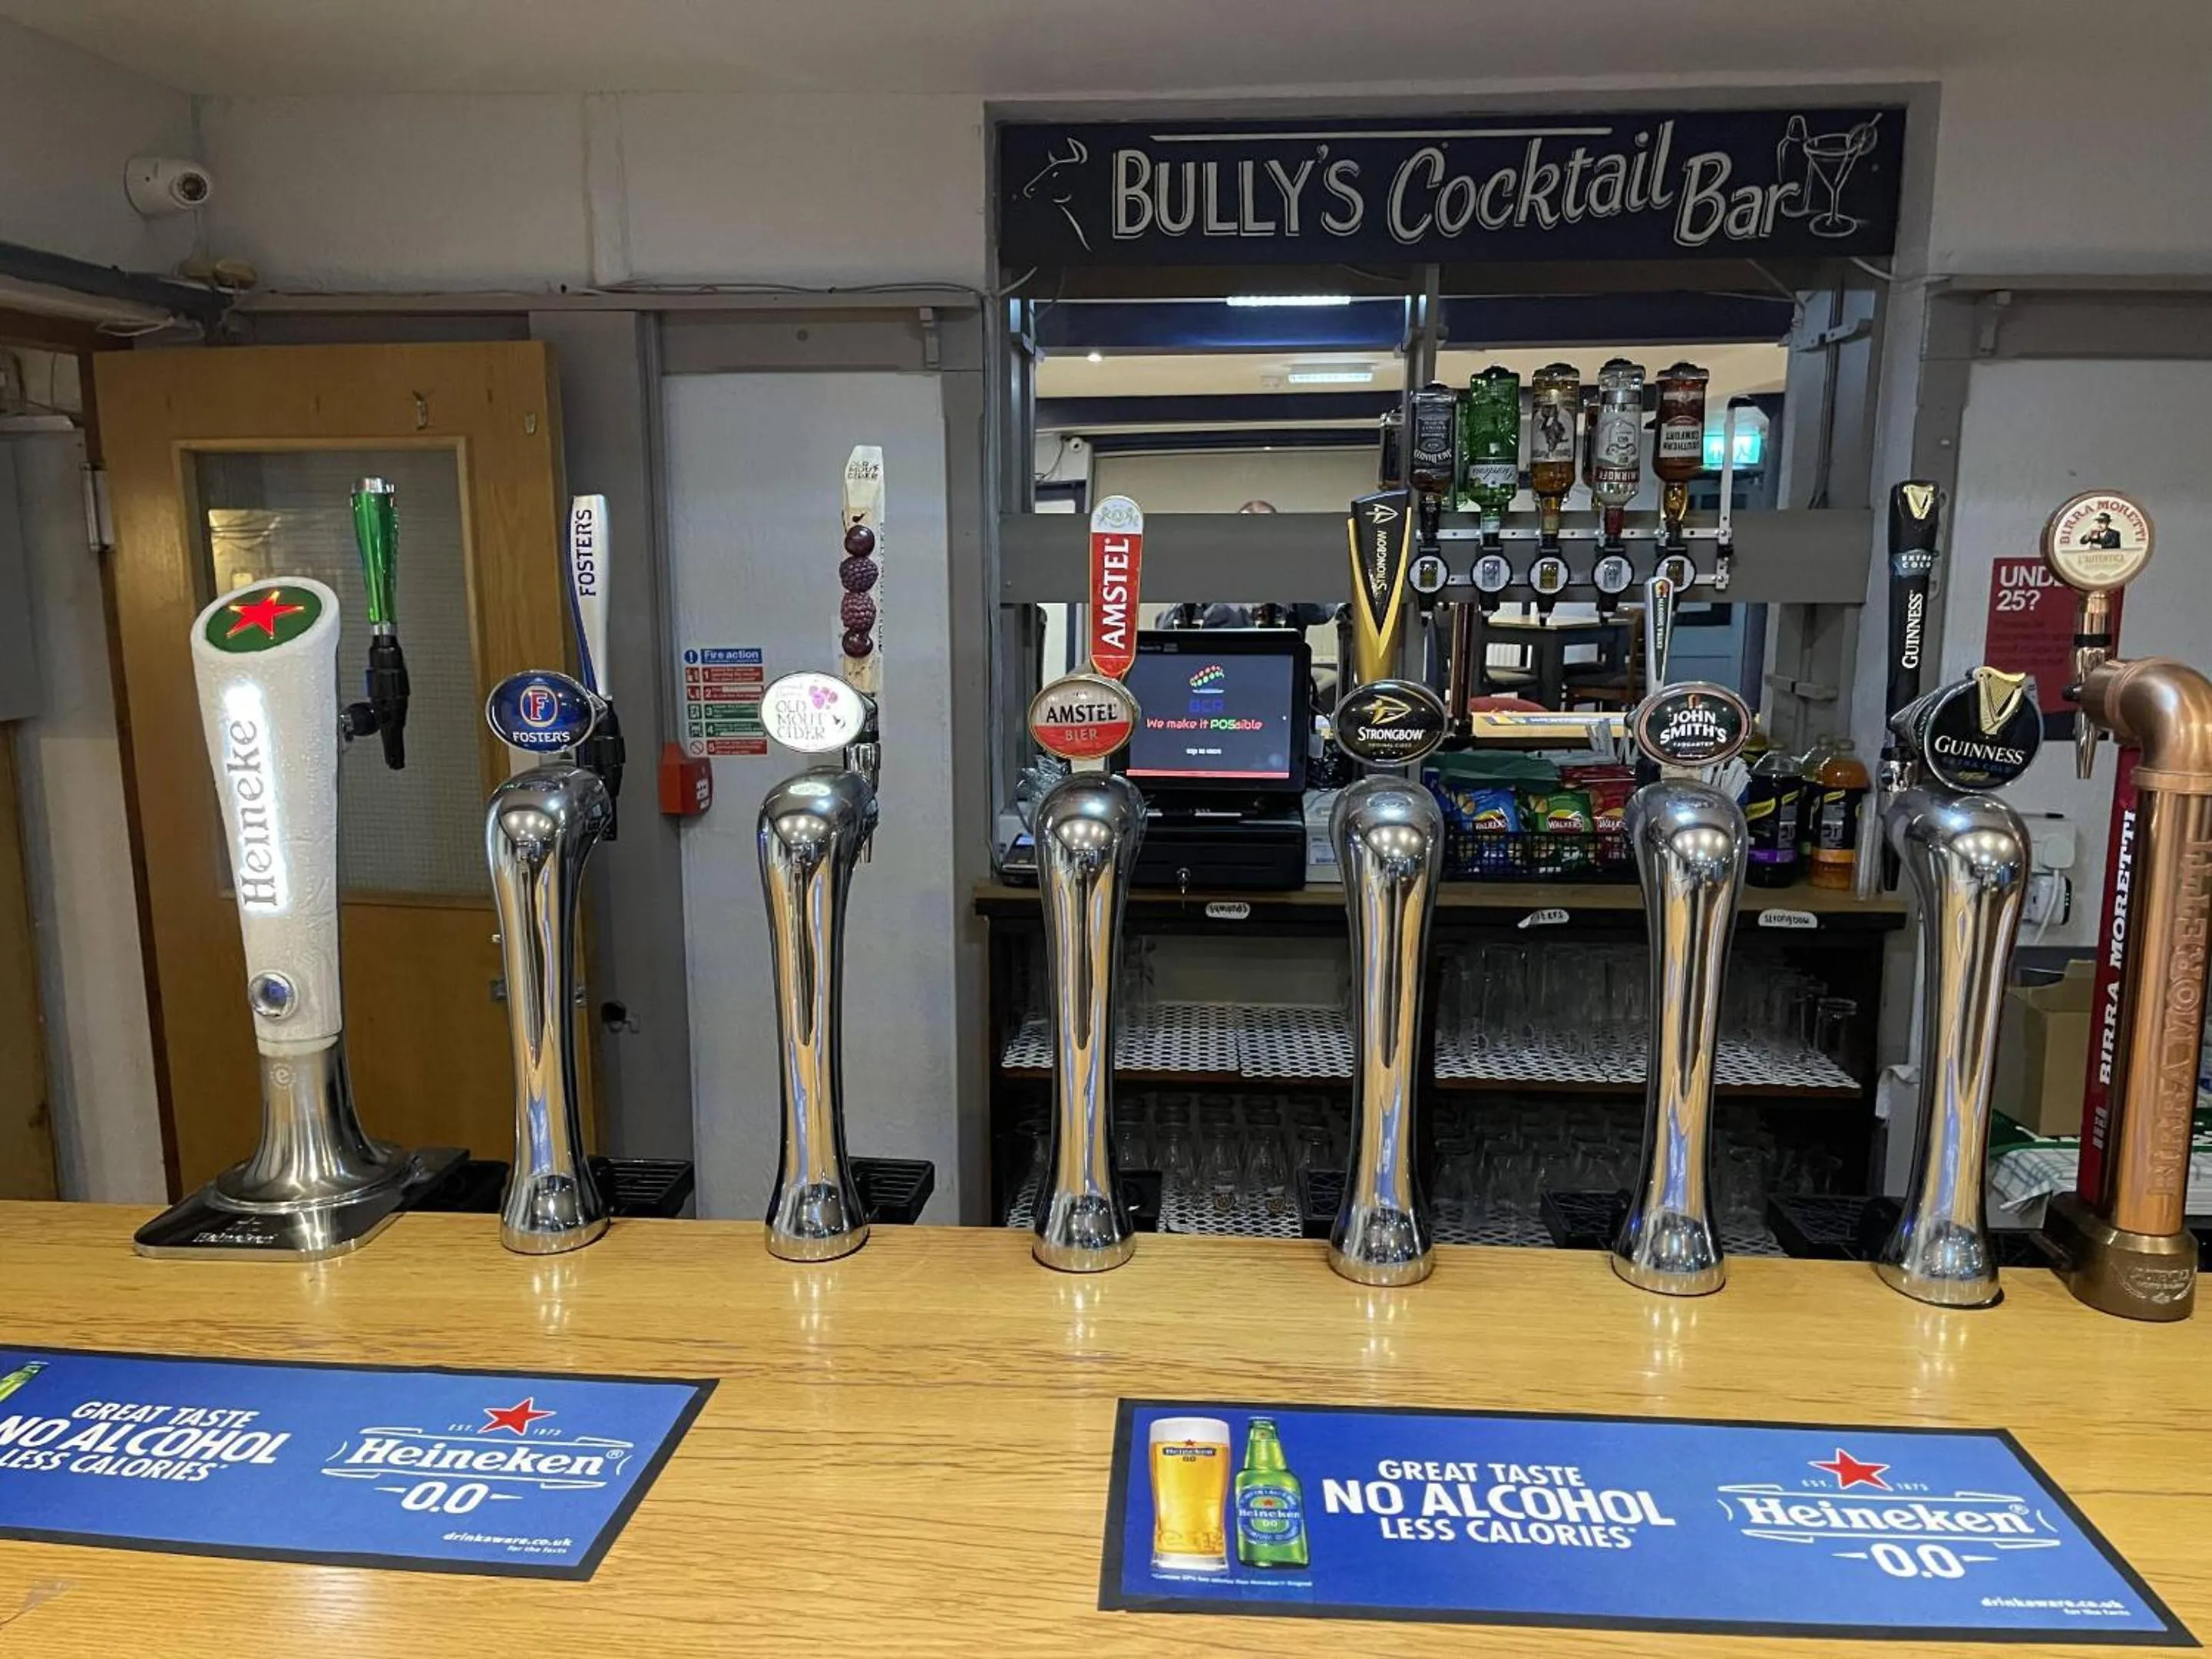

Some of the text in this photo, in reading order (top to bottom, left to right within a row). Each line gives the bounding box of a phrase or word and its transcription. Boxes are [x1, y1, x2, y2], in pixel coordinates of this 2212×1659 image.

[1113, 120, 1801, 248] BULLY'S Cocktail Bar
[2059, 500, 2146, 544] BIRRA MORETTI
[575, 509, 597, 597] FOSTER'S
[1377, 530, 1387, 590] STRONGBOW
[1999, 566, 2064, 587] UND
[1101, 537, 1130, 649] AMSTEL
[1996, 589, 2042, 612] 25?
[1901, 593, 1923, 669] GUINNESS
[704, 650, 759, 659] Fire action
[530, 690, 550, 721] F
[775, 699, 807, 713] OLD
[1046, 703, 1118, 724] AMSTEL
[1669, 709, 1716, 726] JOHN
[512, 730, 570, 743] FOSTER'S
[1065, 728, 1099, 742] BIER
[1146, 718, 1263, 730] We make it POSsible
[1357, 726, 1427, 741] STRONGBOW
[1660, 722, 1727, 745] SMITH'S
[1934, 735, 2026, 765] GUINNESS
[226, 718, 278, 908] Heineke
[1547, 819, 1583, 829] WALKERS
[2109, 810, 2137, 972] MORETTI
[2147, 838, 2212, 1196] BIRRA MORETTI
[2098, 980, 2121, 1086] BIRRA
[71, 1401, 261, 1429] GREAT TASTE
[0, 1415, 293, 1464] NO ALCOHOL
[447, 1423, 473, 1433] EST.
[0, 1448, 71, 1471] LESS
[1164, 1447, 1215, 1456] Heineken
[1377, 1459, 1585, 1488] GREAT TASTE
[1801, 1479, 1834, 1489] EST.
[399, 1481, 490, 1515] 0.0
[1321, 1479, 1404, 1516] NO
[1420, 1482, 1677, 1527] ALCOHOL
[1238, 1509, 1301, 1519] Heineken
[442, 1532, 574, 1547] drinkaware.co.uk
[1380, 1517, 1456, 1542] LESS
[1870, 1542, 1966, 1579] 0.0
